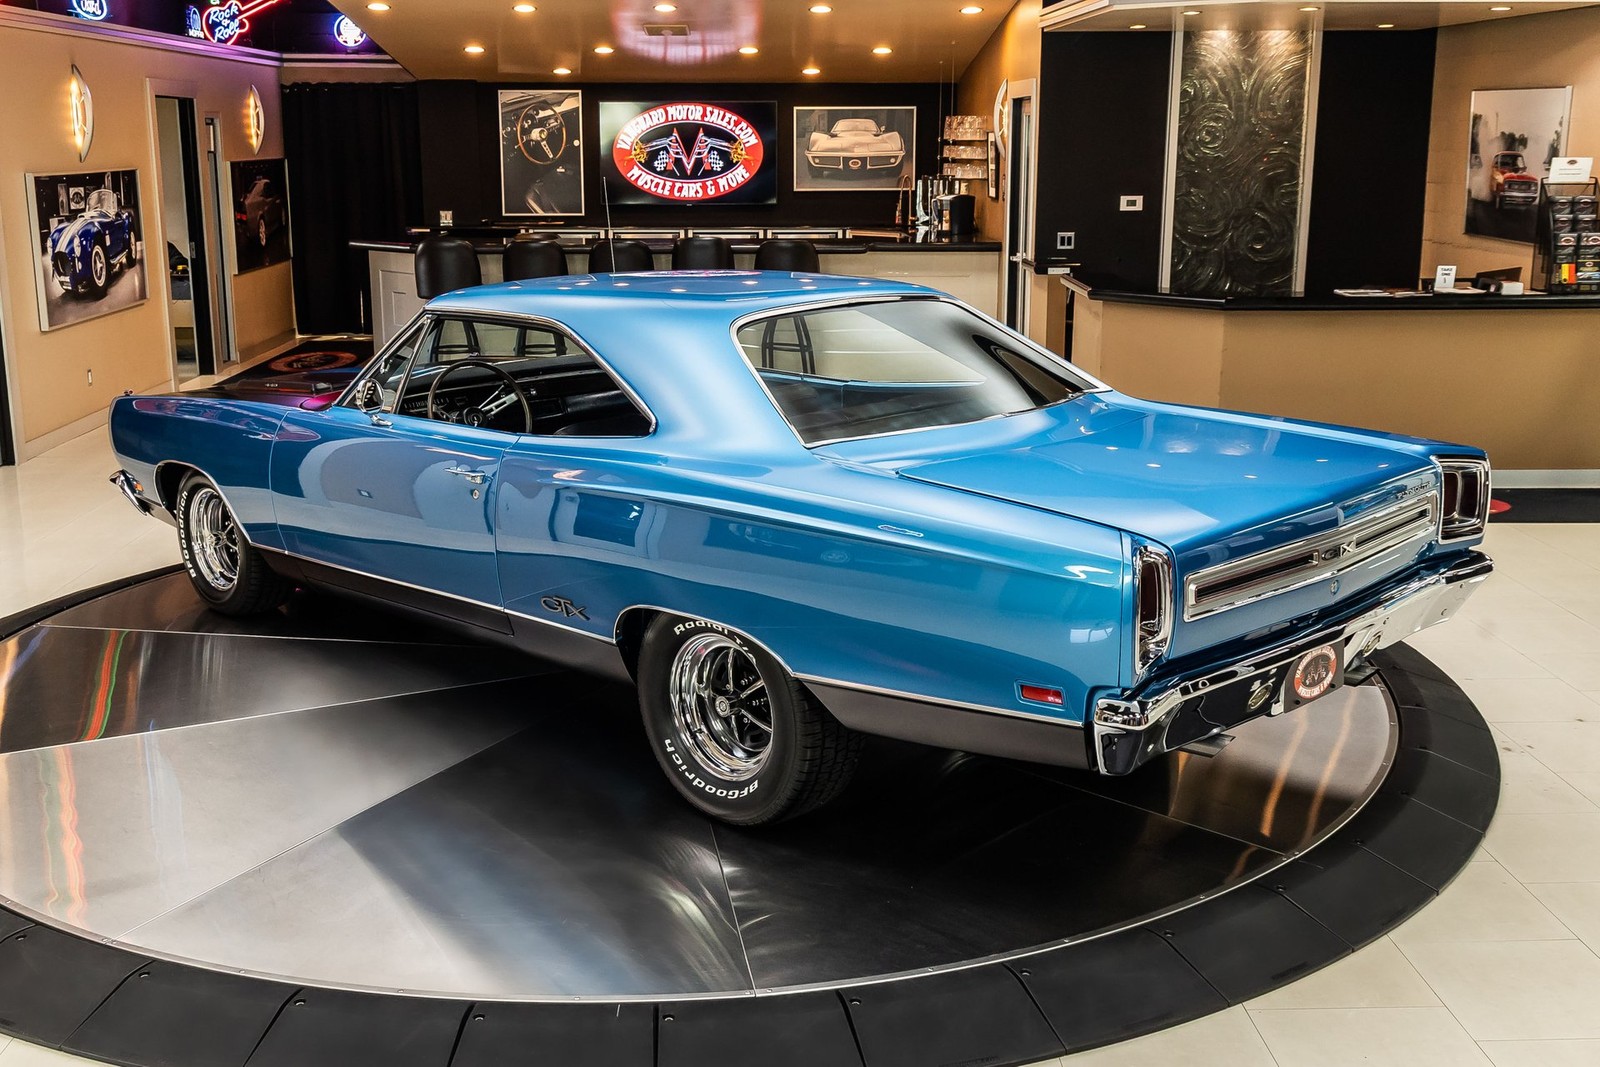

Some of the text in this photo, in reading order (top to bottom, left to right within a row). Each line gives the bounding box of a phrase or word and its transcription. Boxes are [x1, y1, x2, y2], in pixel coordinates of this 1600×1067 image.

[209, 2, 239, 24] Rock
[213, 18, 240, 43] Roll
[616, 104, 759, 150] VANGUARD MOTOR SALES.COM
[626, 165, 751, 198] MUSCLE CARS & MORE
[541, 595, 590, 621] GTX
[673, 620, 729, 636] Radial
[664, 738, 759, 799] BFGoodrich
